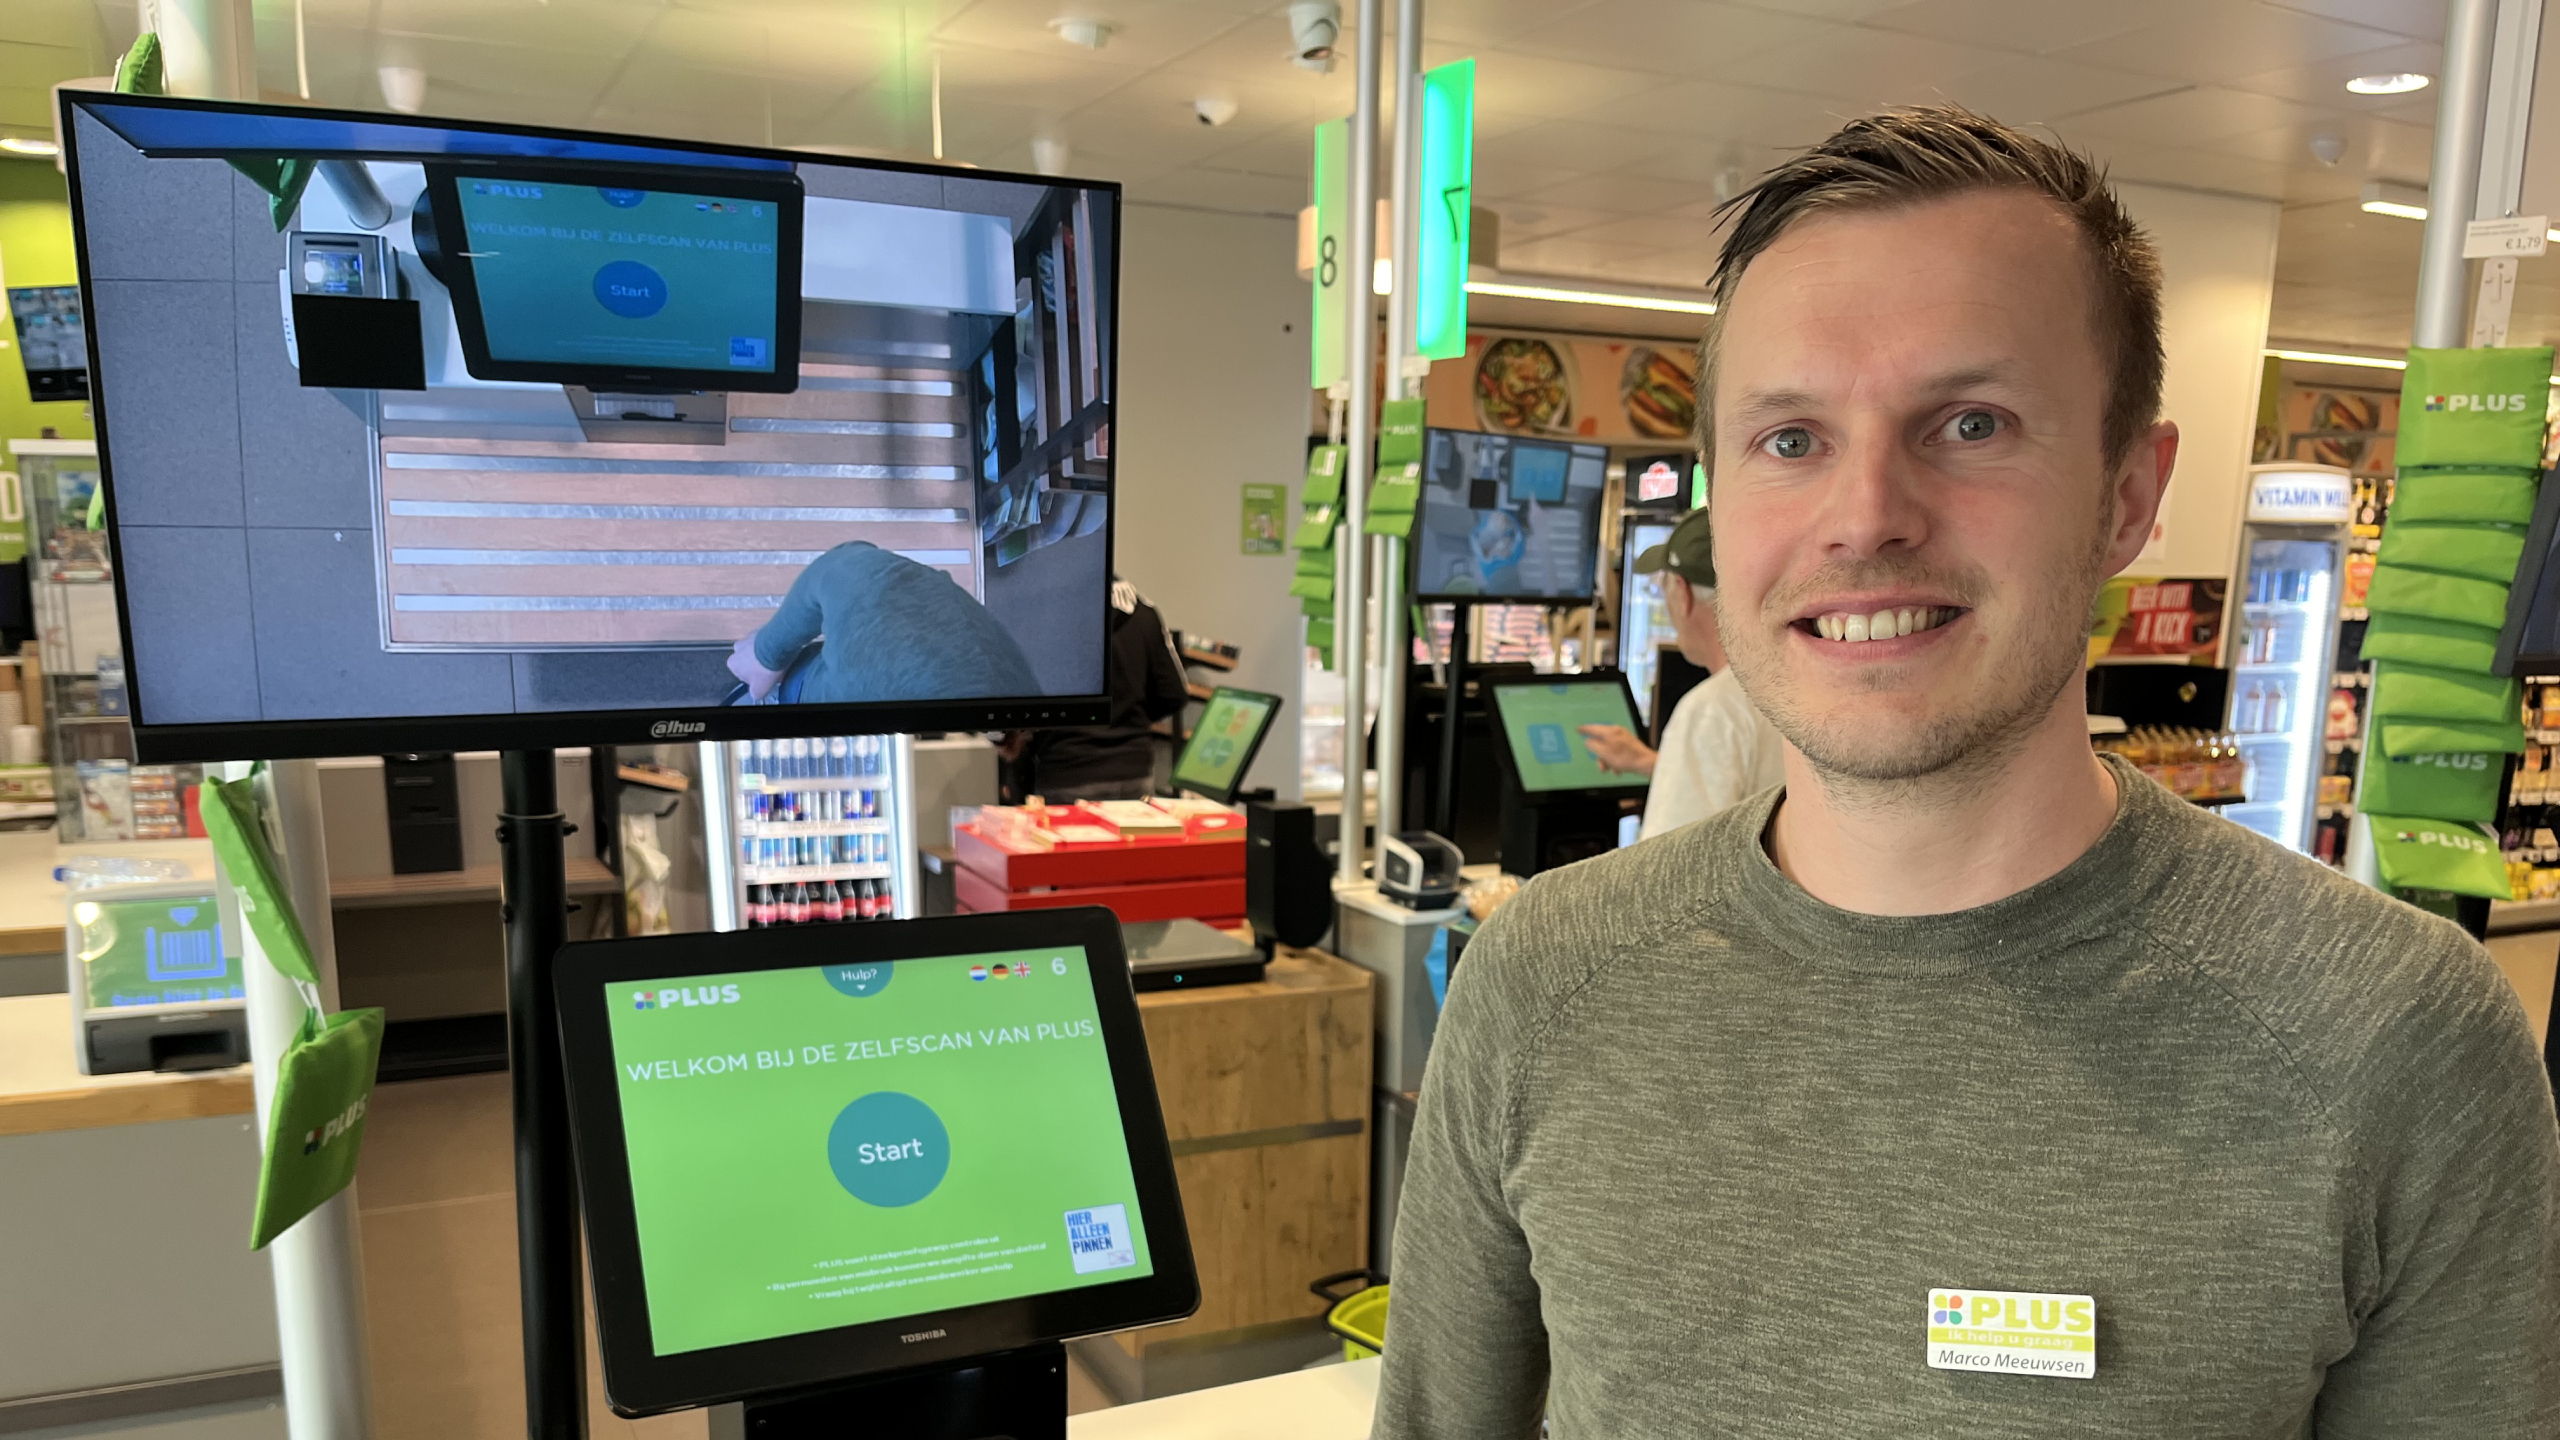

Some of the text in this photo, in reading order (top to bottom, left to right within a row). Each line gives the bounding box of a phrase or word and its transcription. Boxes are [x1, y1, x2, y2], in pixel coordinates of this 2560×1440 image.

[490, 184, 544, 200] PLUS
[1320, 234, 1337, 289] 8
[610, 284, 651, 299] Start
[2448, 393, 2527, 412] PLUS
[2254, 486, 2321, 508] VITAMIN
[2419, 831, 2489, 855] PLUS
[841, 968, 879, 983] Hulp?
[1051, 956, 1068, 976] 6
[658, 983, 741, 1010] PLUS
[626, 1018, 1095, 1083] WELKOM BIJ DE ZELFSCAN VAN PLUS
[321, 1092, 368, 1147] PLUS
[857, 1137, 925, 1165] Start
[1067, 1210, 1093, 1227] HIER
[1070, 1221, 1111, 1241] ALLEEN
[1072, 1236, 1114, 1255] PINNEN
[819, 1258, 844, 1269] PLUS
[1970, 1295, 2093, 1333] PLUS
[900, 1328, 948, 1345] TOSHIBA
[1967, 1330, 2005, 1345] help
[2008, 1334, 2020, 1344] u
[2023, 1336, 2074, 1349] graag
[1938, 1349, 2086, 1374] Marco Meeuwsen
